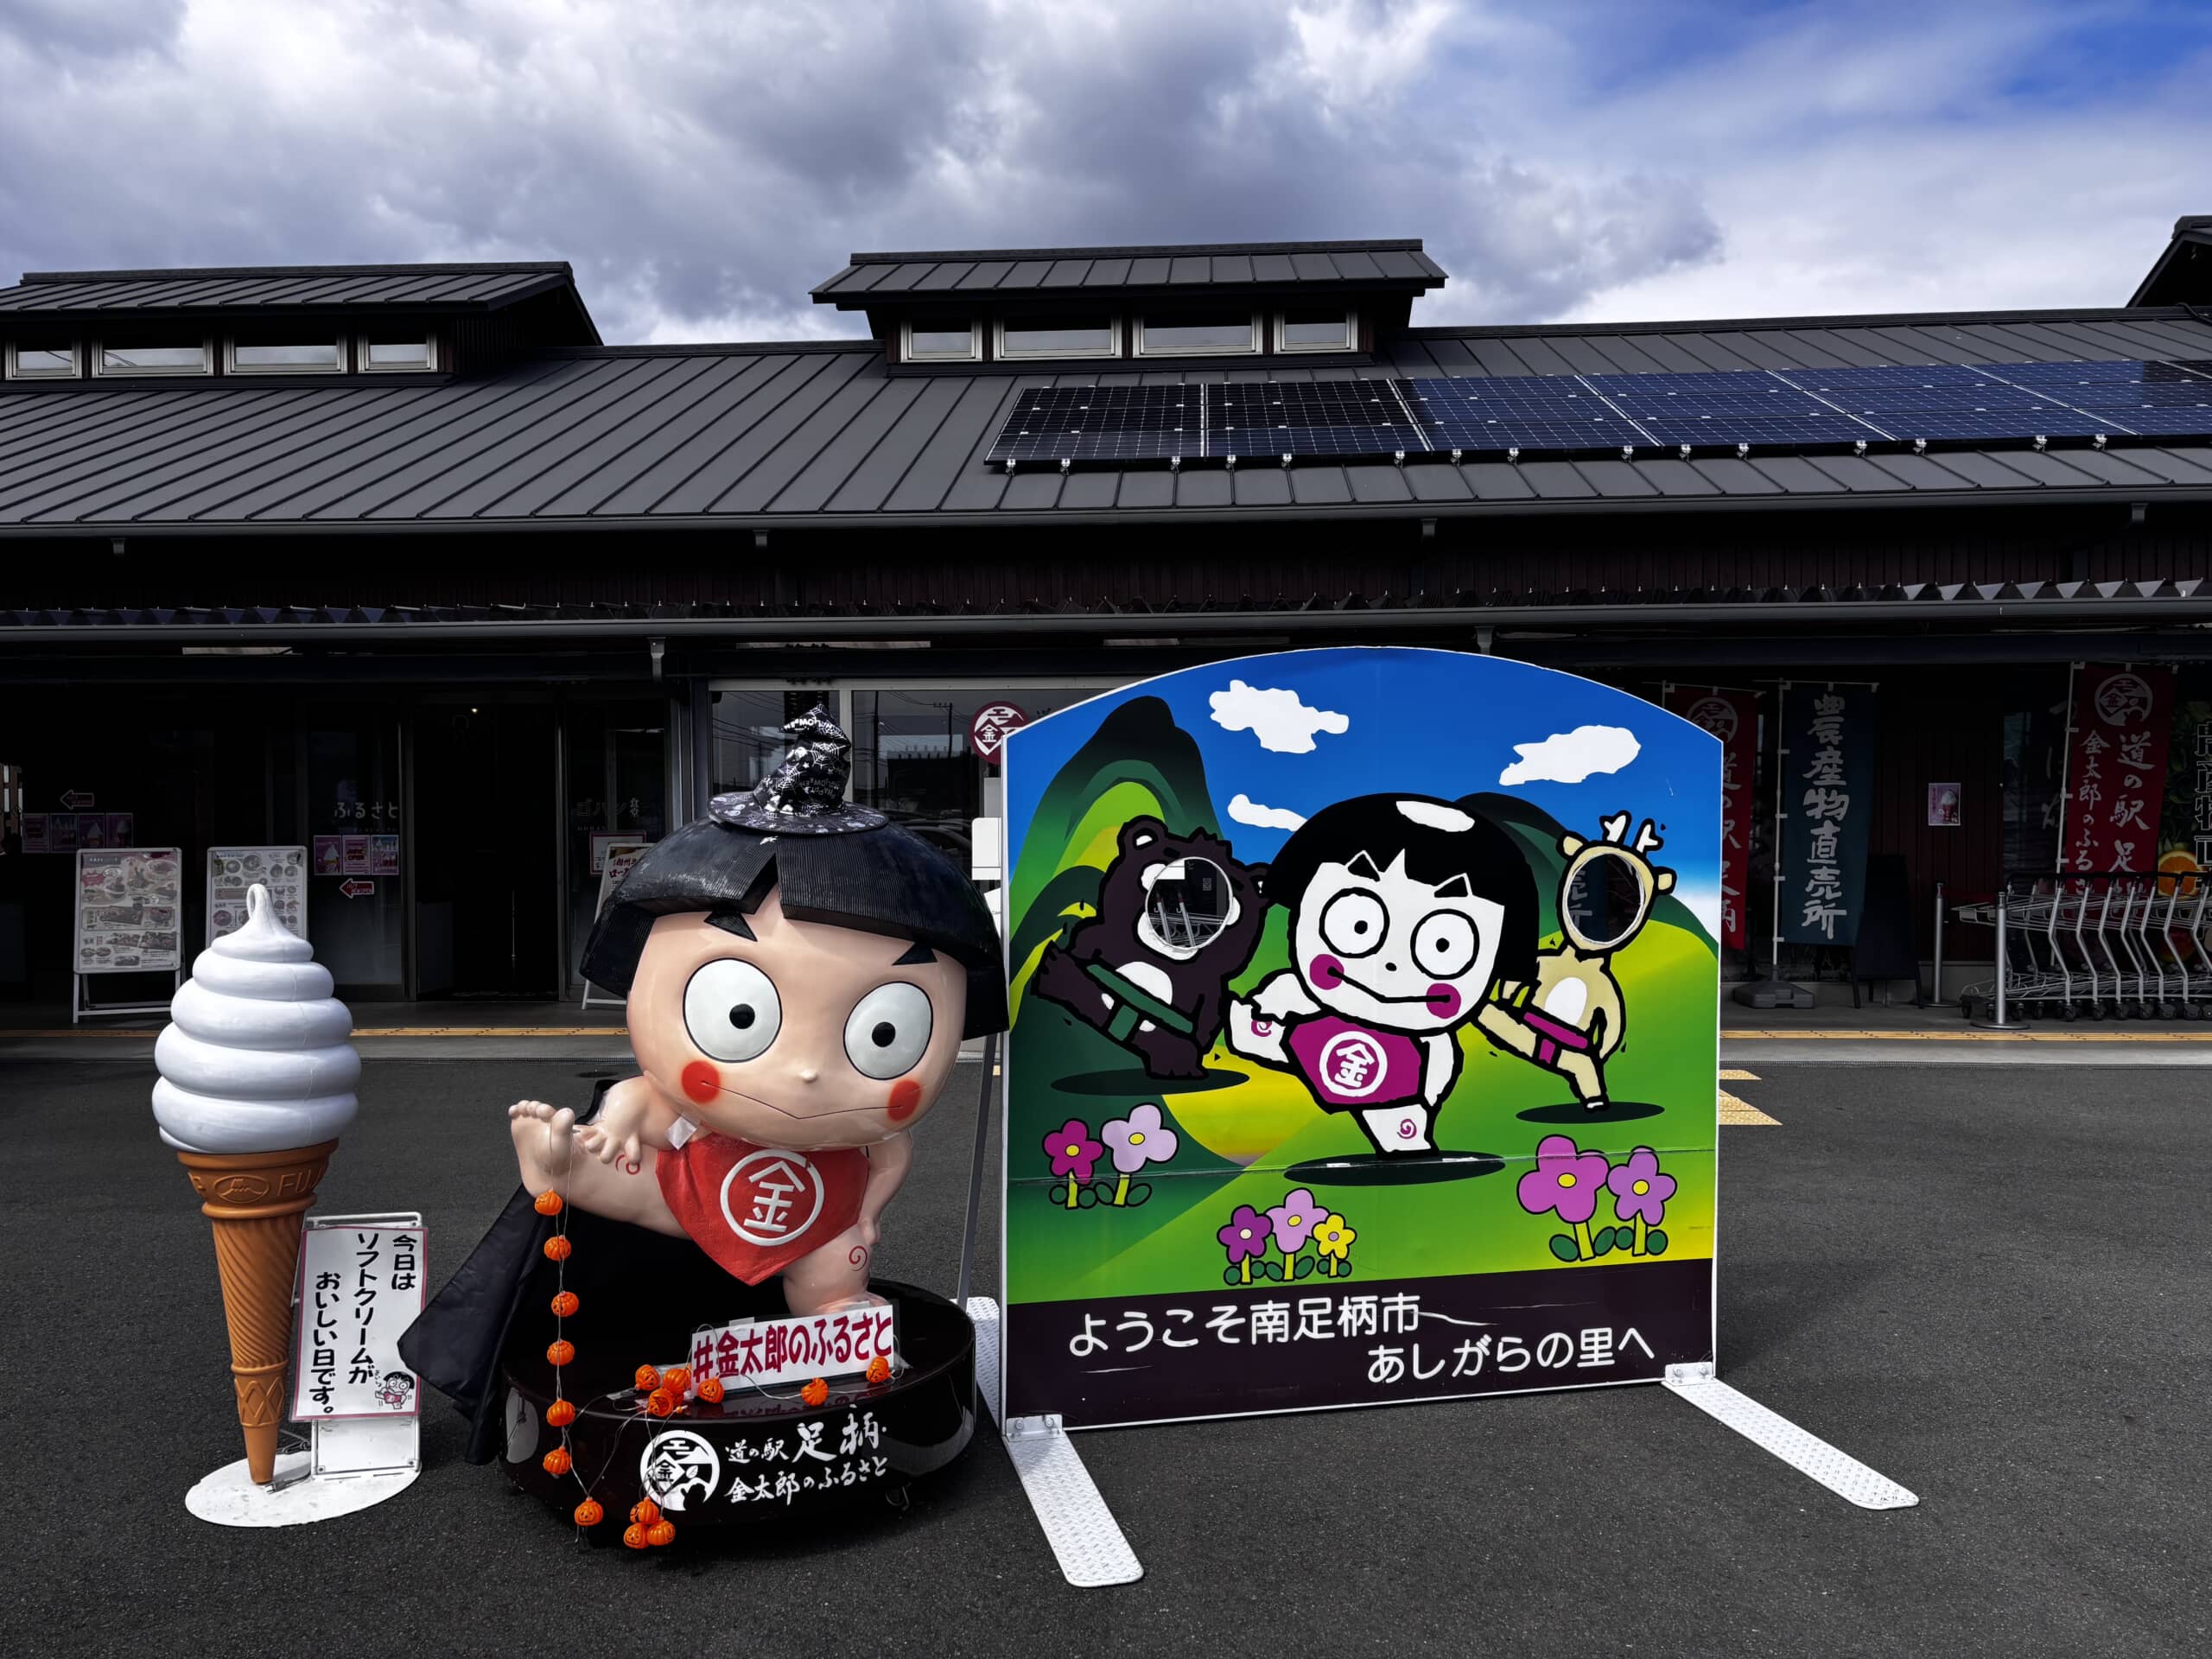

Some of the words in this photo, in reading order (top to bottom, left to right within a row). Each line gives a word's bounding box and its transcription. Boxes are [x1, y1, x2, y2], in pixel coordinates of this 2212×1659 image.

[334, 801, 398, 820] ふるさと
[1802, 693, 1850, 940] 農産物直売所
[2075, 729, 2110, 896] 金太郎のふるさ
[2108, 730, 2156, 894] 道の駅足
[1334, 1042, 1376, 1088] 金
[742, 1160, 806, 1233] 金
[391, 1234, 417, 1291] 今日は
[308, 1271, 341, 1414] おいしい日です。
[347, 1232, 380, 1385] ソフトクリームが
[1068, 1292, 1421, 1357] ようこそ南足柄市
[1367, 1326, 1656, 1384] あしがらの里へ
[723, 1455, 889, 1506] 金太郎のふるさと
